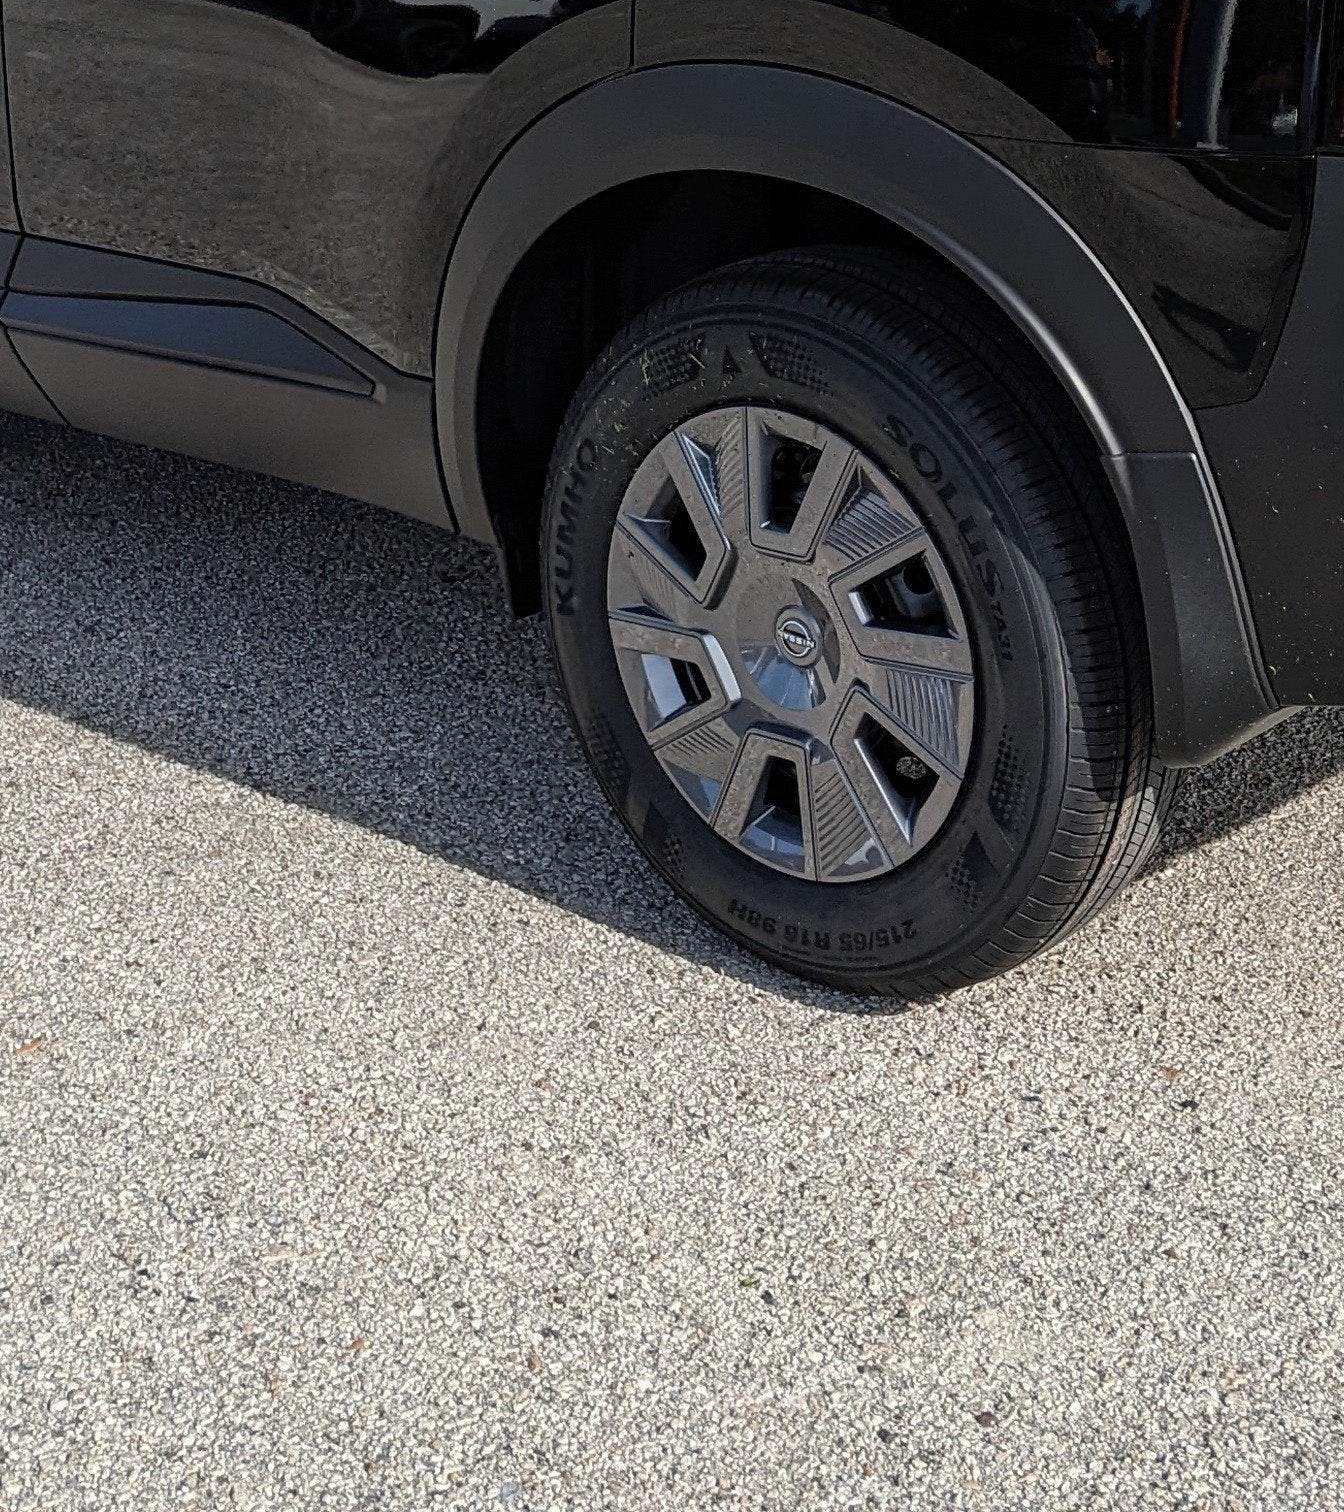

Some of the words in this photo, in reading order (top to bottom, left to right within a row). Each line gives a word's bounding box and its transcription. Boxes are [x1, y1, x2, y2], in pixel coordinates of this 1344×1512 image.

[555, 438, 597, 616] KUMHO
[882, 414, 1005, 598] SOLUS
[838, 918, 917, 952] 215/65
